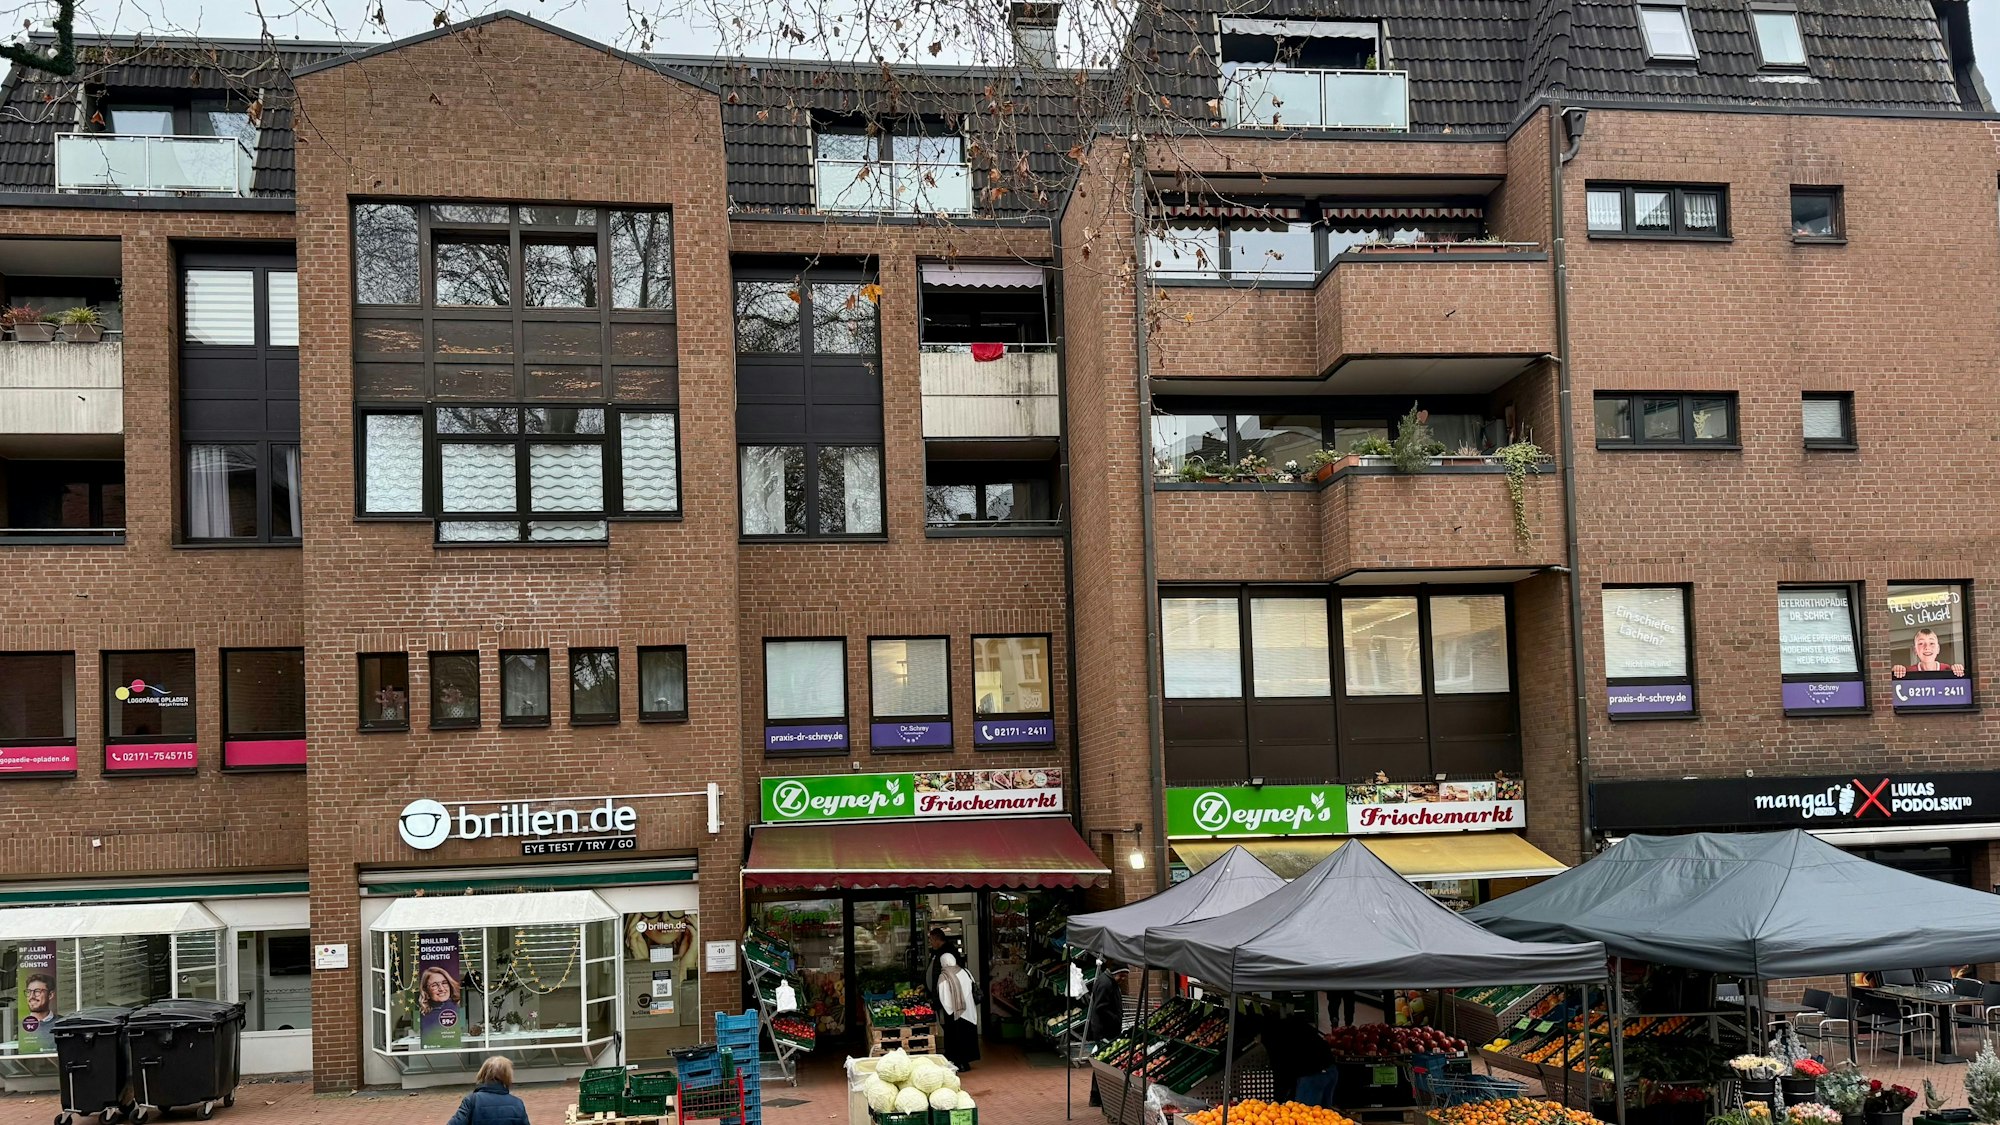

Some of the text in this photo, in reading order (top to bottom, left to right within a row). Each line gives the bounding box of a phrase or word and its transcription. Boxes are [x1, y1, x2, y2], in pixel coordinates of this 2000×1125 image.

[1889, 592, 1960, 613] ALL YOU NEED
[1616, 605, 1676, 633] Ein schiefes
[1804, 611, 1834, 620] SCHREY
[1903, 606, 1951, 625] IS LAUGH!
[1818, 684, 1839, 692] Schrey
[1908, 687, 1936, 697] 02171
[1944, 686, 1964, 696] 2411
[127, 696, 160, 704] LOGOPÄDIE
[1609, 692, 1687, 705] praxis-dr-schrey.de
[909, 725, 929, 733] Schrey
[994, 727, 1020, 737] 02171
[1027, 727, 1047, 736] 2411
[771, 732, 843, 743] praxis-dr-schrey.de
[122, 751, 193, 761] 02171-7545715
[1891, 782, 1935, 796] LUKAS
[775, 783, 905, 816] Zeynep's
[919, 792, 1058, 812] Frischemarkt
[1754, 786, 1837, 818] mangal
[458, 798, 637, 839] brillen.de
[1195, 795, 1331, 831] Zeynep's
[1360, 805, 1514, 827] Frischemarkt
[524, 844, 545, 854] EYE
[549, 842, 574, 853] TEST
[586, 840, 606, 851] TRY
[618, 839, 634, 849] GO
[648, 921, 687, 931] brillen.de
[420, 937, 449, 945] BRILLEN
[420, 945, 458, 953] DISCOUNT-
[421, 953, 451, 961] GÜNSTIG
